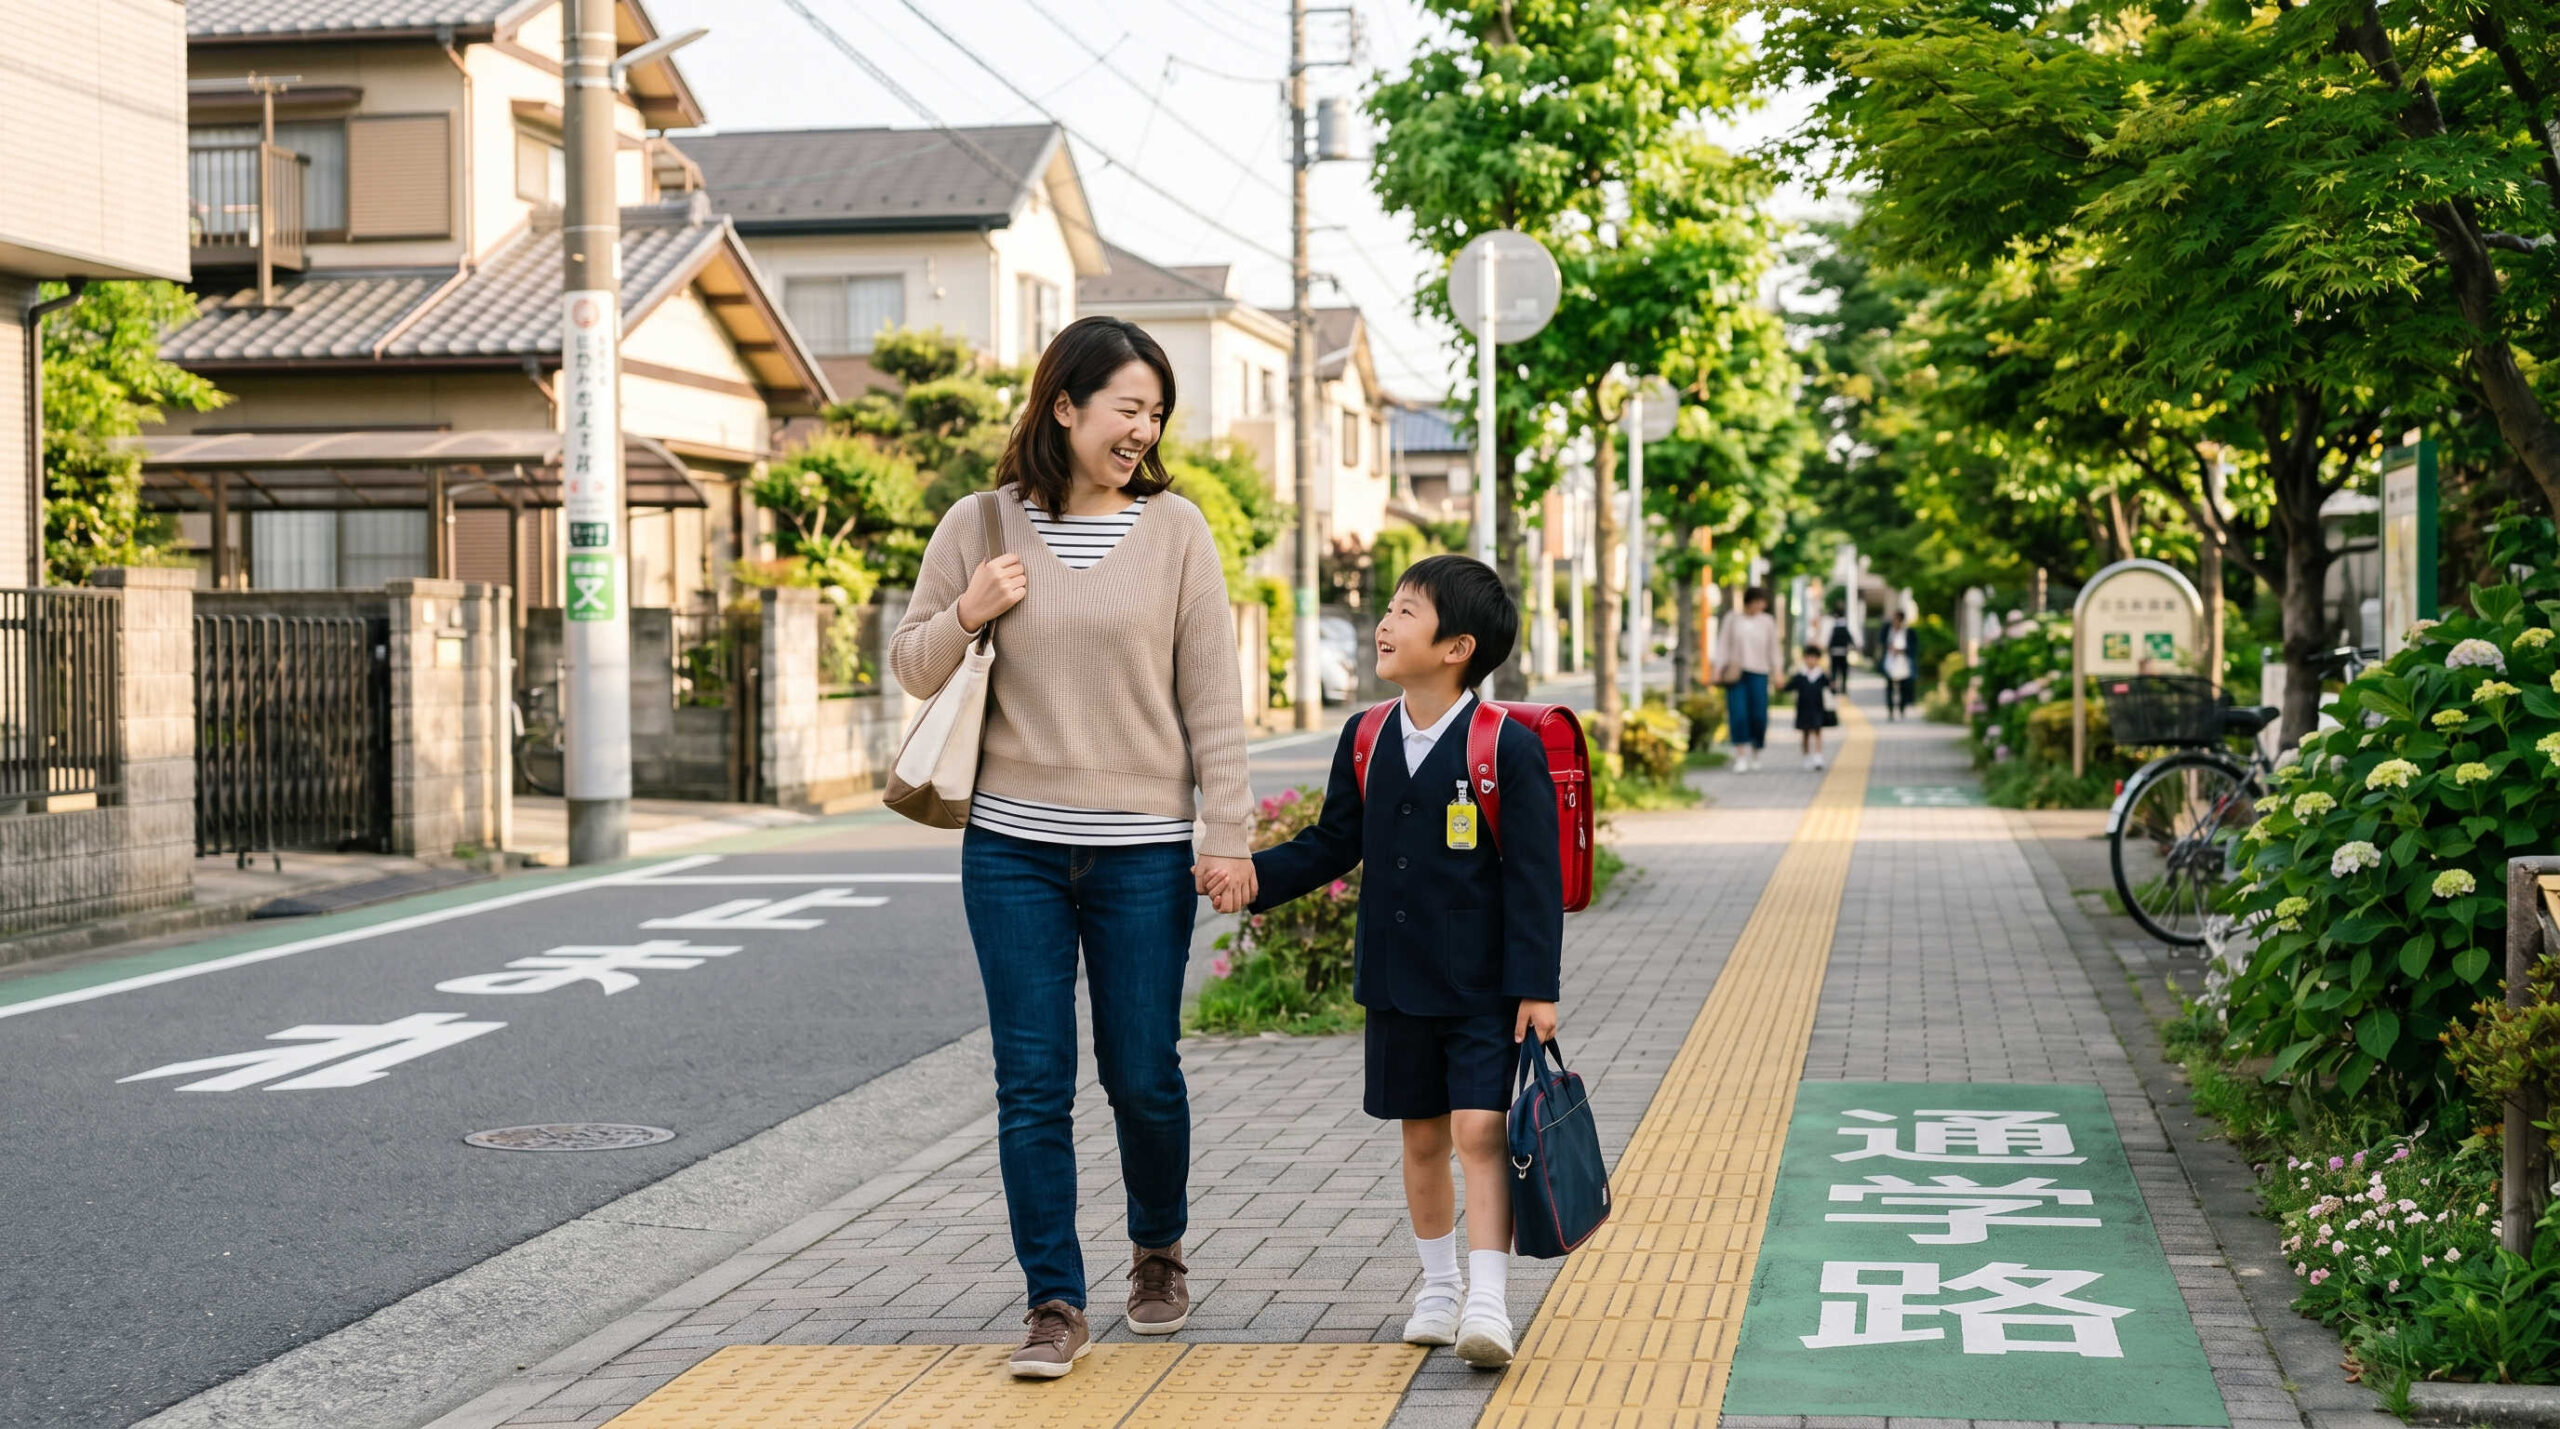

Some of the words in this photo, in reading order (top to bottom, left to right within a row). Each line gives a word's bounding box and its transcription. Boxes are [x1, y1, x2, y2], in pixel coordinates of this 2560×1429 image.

[116, 888, 890, 1092] 止まれ
[1798, 1108, 2137, 1358] 通学路
